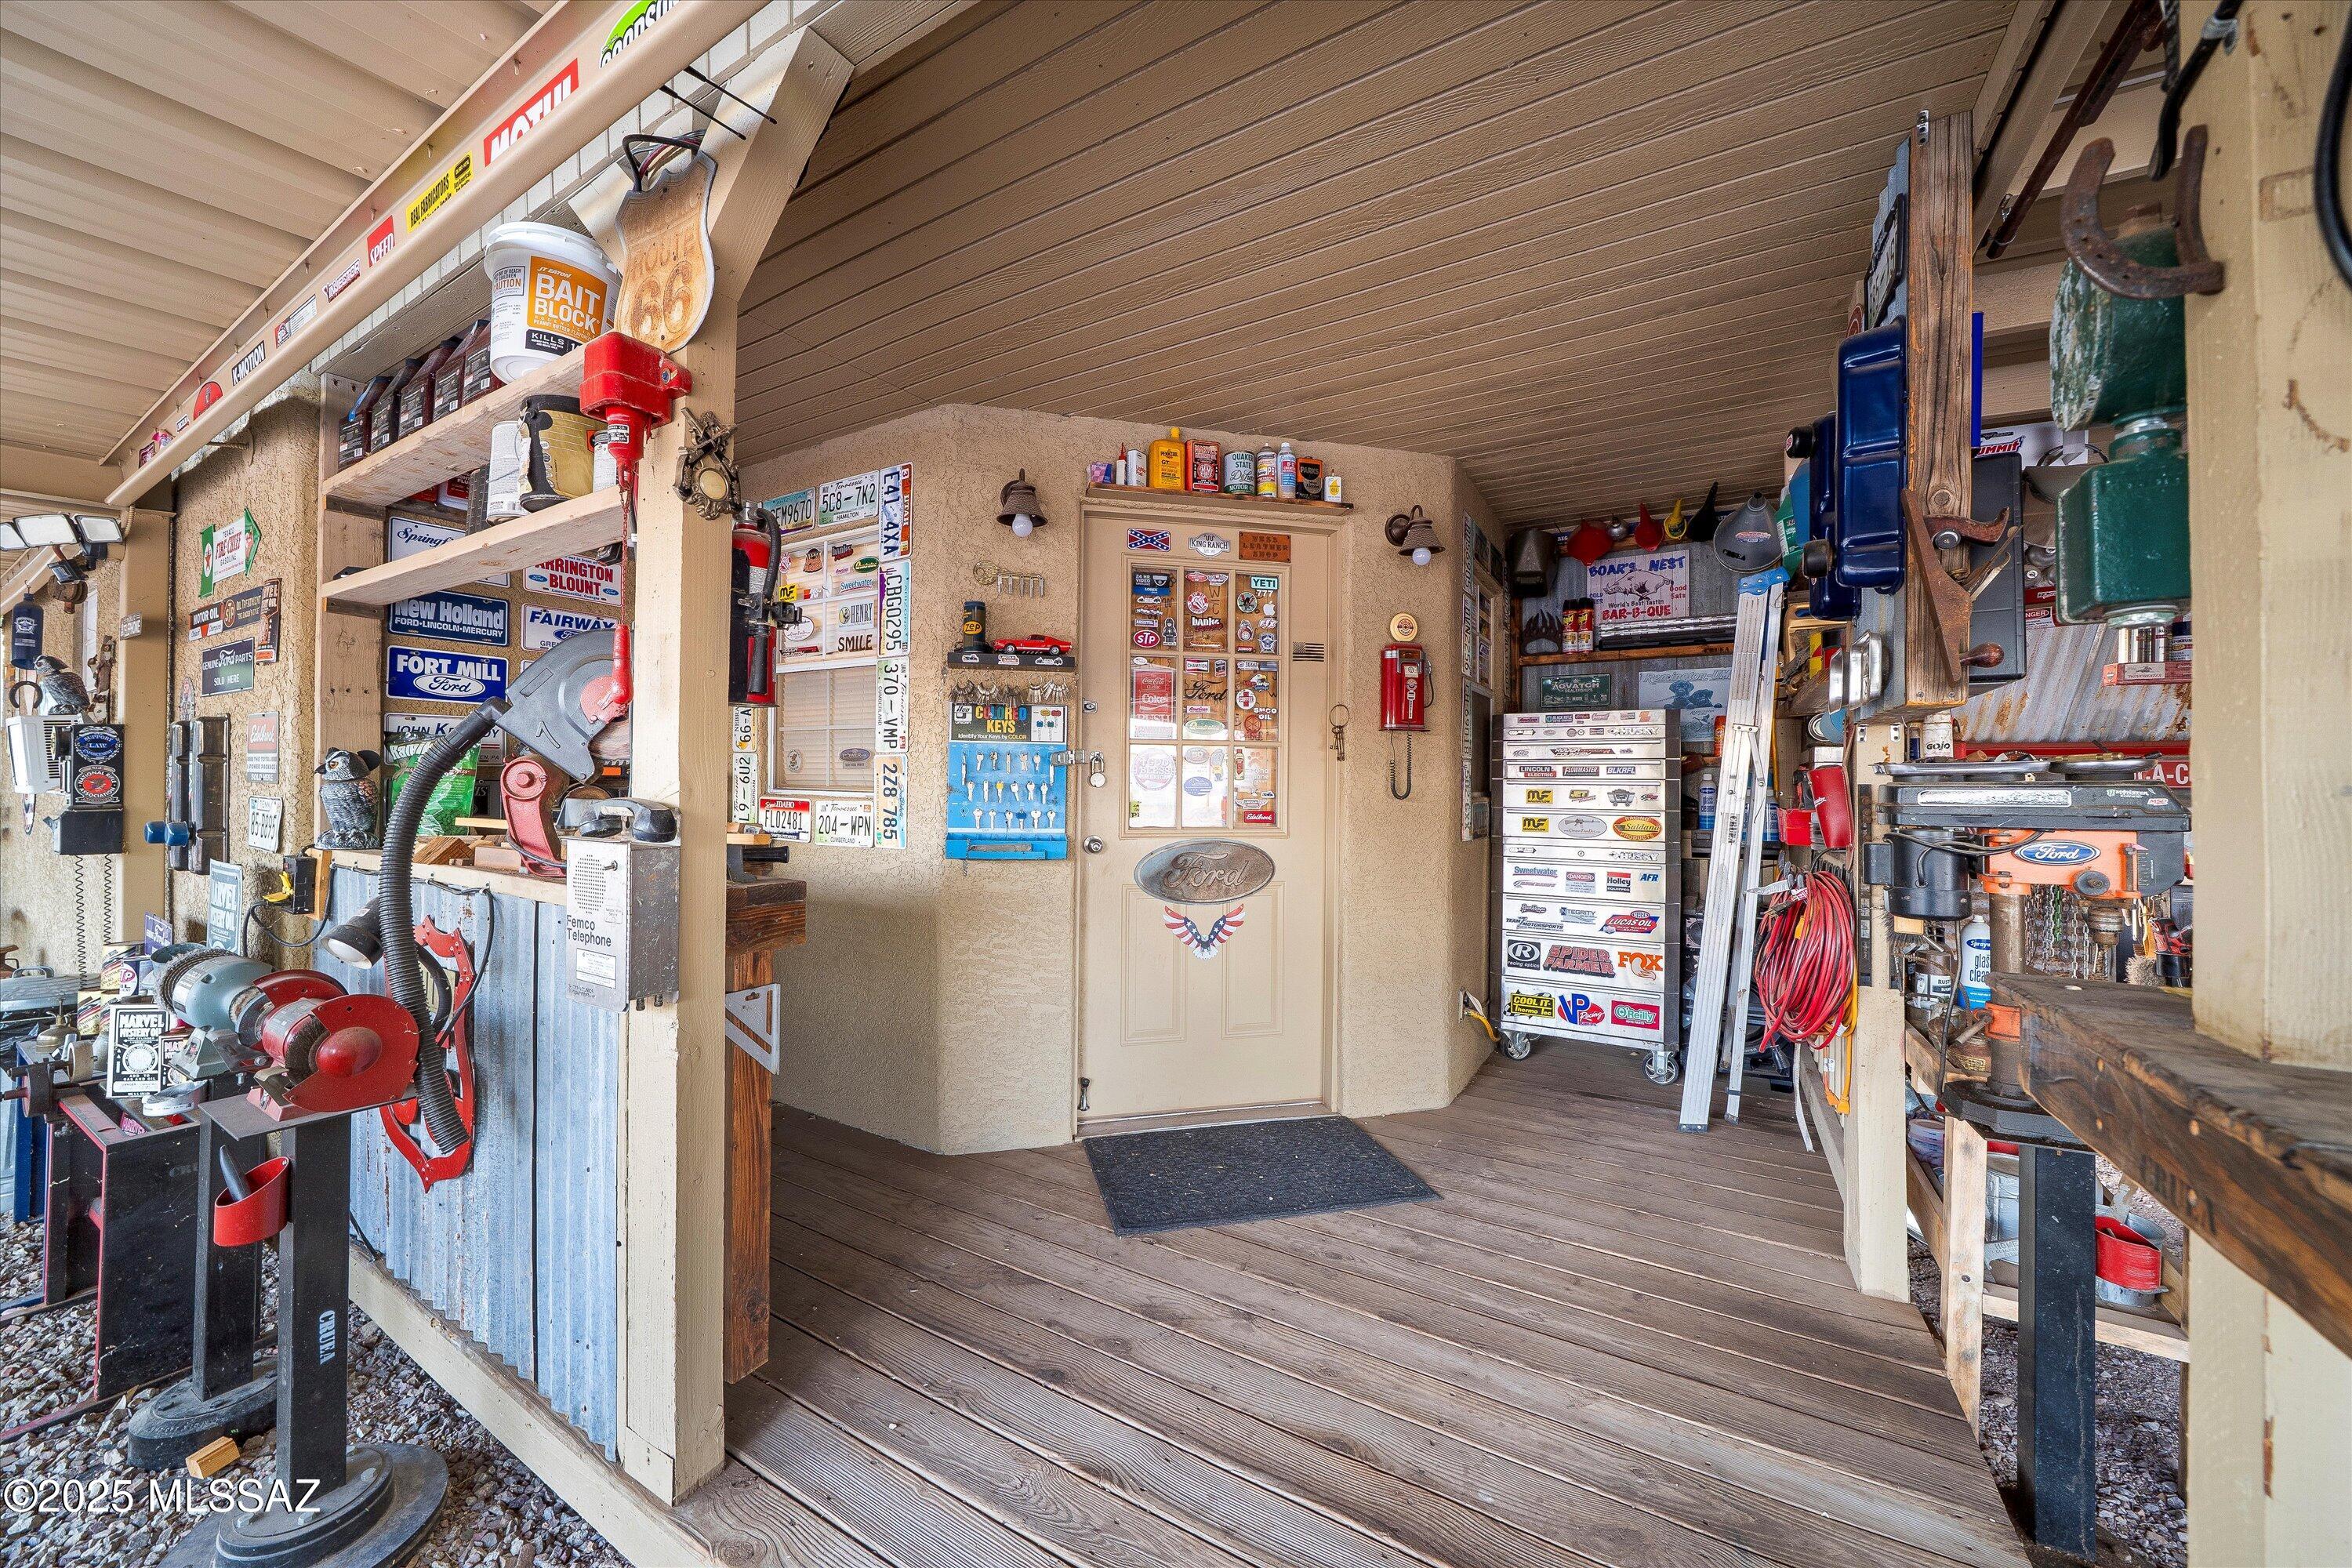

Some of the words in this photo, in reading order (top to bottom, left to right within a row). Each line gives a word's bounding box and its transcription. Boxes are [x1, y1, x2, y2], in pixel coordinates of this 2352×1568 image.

[410, 204, 421, 228] REAL
[420, 172, 449, 217] FABRICATORS
[535, 273, 601, 314] BAIT
[630, 260, 694, 339] 66
[532, 332, 564, 345] KILLS
[233, 350, 265, 386] K-MOTION
[836, 510, 860, 521] HAMILTON
[1190, 539, 1206, 549] KING
[1207, 539, 1229, 549] RANCH
[1588, 562, 1637, 577] BOAR'S
[1648, 555, 1686, 572] NEST
[549, 573, 601, 596] BLOUNT
[840, 579, 873, 590] Sweetwater
[1252, 578, 1276, 588] YETI
[193, 608, 210, 626] MOTOR
[209, 607, 220, 619] OIL
[394, 598, 437, 620] New
[439, 601, 504, 629] Holland
[529, 610, 615, 631] FAIRWAY
[851, 602, 874, 623] HENRY
[1602, 604, 1671, 621] BAR-B-QUE
[1192, 616, 1221, 626] banks
[837, 634, 873, 652] SMILE
[219, 648, 236, 668] Ford
[235, 652, 252, 664] PARTS
[397, 654, 451, 675] FORT
[456, 660, 501, 682] MILL
[213, 677, 225, 687] SOLD
[227, 673, 240, 684] HERE
[429, 677, 471, 693] Ford
[1184, 680, 1229, 701] Ford
[975, 705, 1027, 720] COLORED
[986, 719, 1016, 734] KEYS
[1620, 727, 1660, 736] HUSKY
[1926, 741, 1951, 750] GOJO
[78, 770, 103, 785] NATIONAL
[78, 786, 117, 798] ASSOCIATION
[775, 800, 795, 809] IDAHO
[829, 804, 858, 813] Tennessee
[1624, 822, 1661, 831] Saldana
[1619, 851, 1660, 862] HUSKY
[2033, 844, 2080, 861] Ford
[1163, 851, 1250, 888] Ford
[1514, 866, 1558, 876] Sweetwater
[1639, 873, 1659, 882] AFR
[1606, 876, 1631, 887] Holley
[567, 914, 596, 931] Femco
[567, 928, 612, 948] Telephone
[1548, 944, 1611, 963] SPIDER
[1617, 951, 1664, 971] FOX
[1974, 953, 1991, 970] glas
[1543, 957, 1617, 978] FARMER
[1513, 995, 1538, 1006] COOL
[1513, 1004, 1539, 1014] Thermo
[1540, 1007, 1552, 1016] Tec
[1559, 993, 1591, 1025] VP
[1579, 1011, 1605, 1020] Racing
[1615, 1006, 1657, 1023] O'Reilly
[118, 1014, 165, 1029] MARVEL
